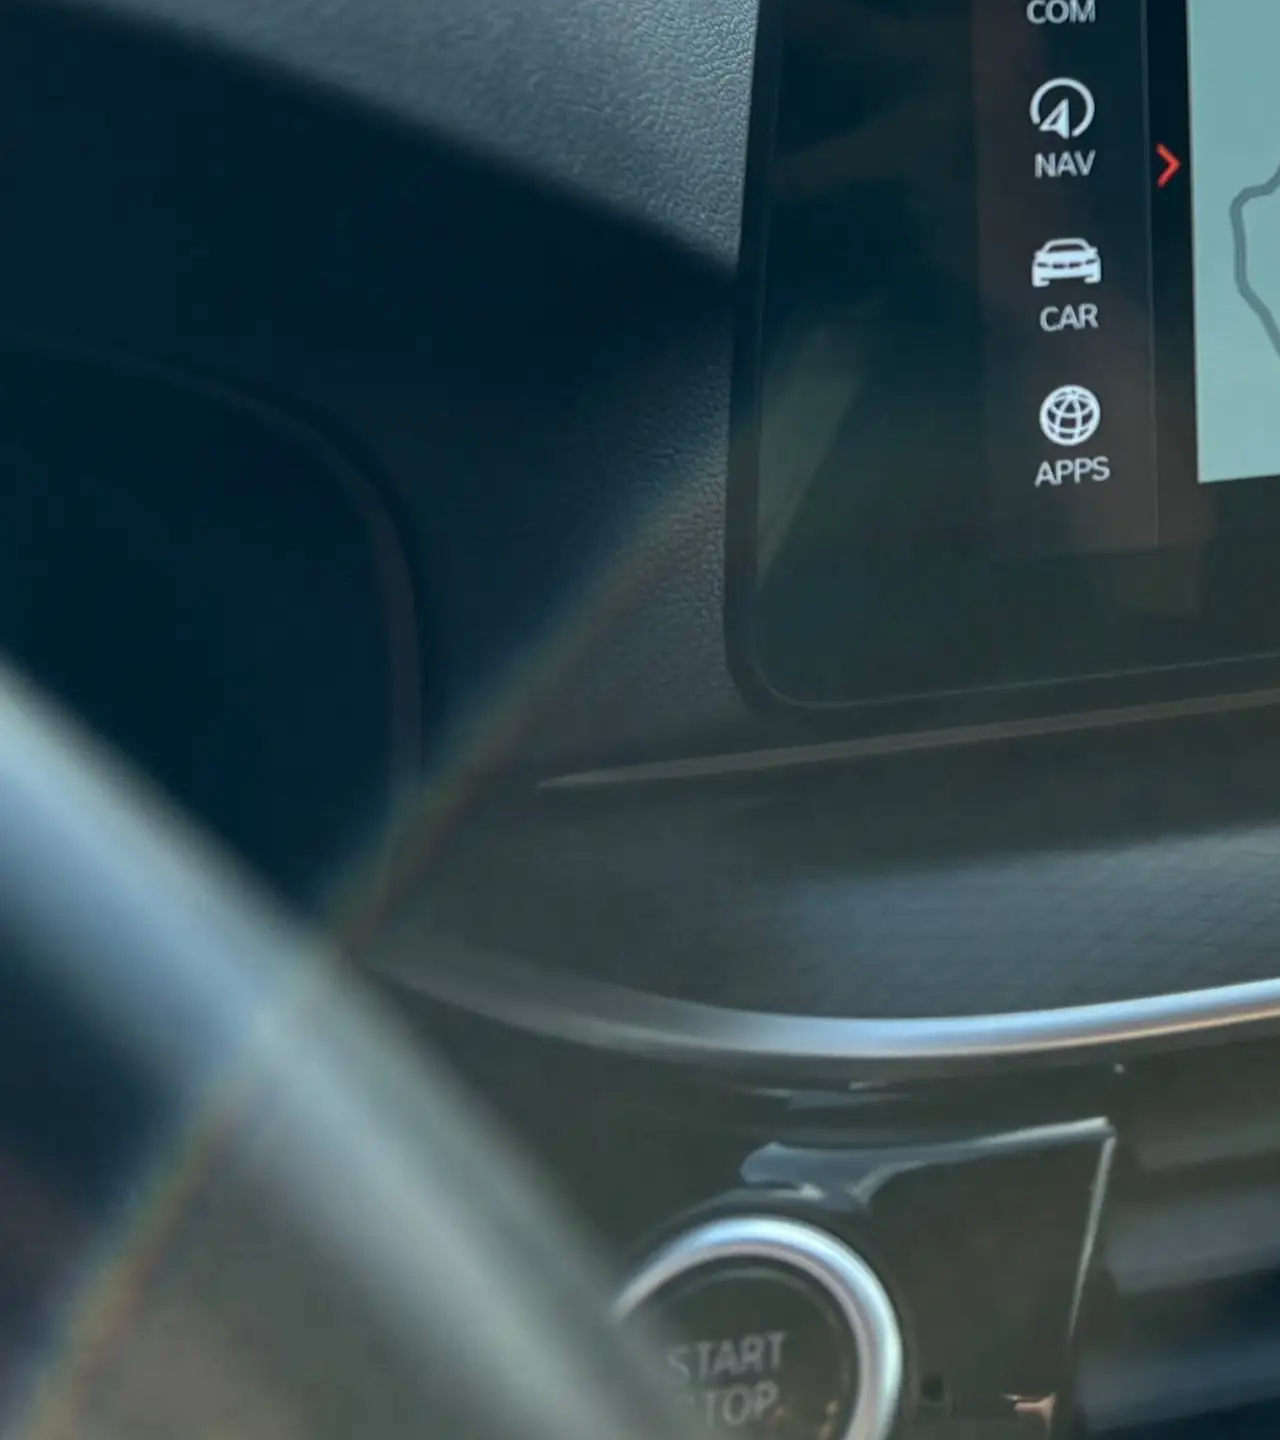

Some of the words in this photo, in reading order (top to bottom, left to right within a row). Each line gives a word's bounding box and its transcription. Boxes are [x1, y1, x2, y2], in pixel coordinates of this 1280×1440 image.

[1034, 149, 1096, 178] NAV
[1039, 303, 1100, 332] CAR
[1034, 456, 1111, 488] APPS
[667, 1331, 786, 1382] START
